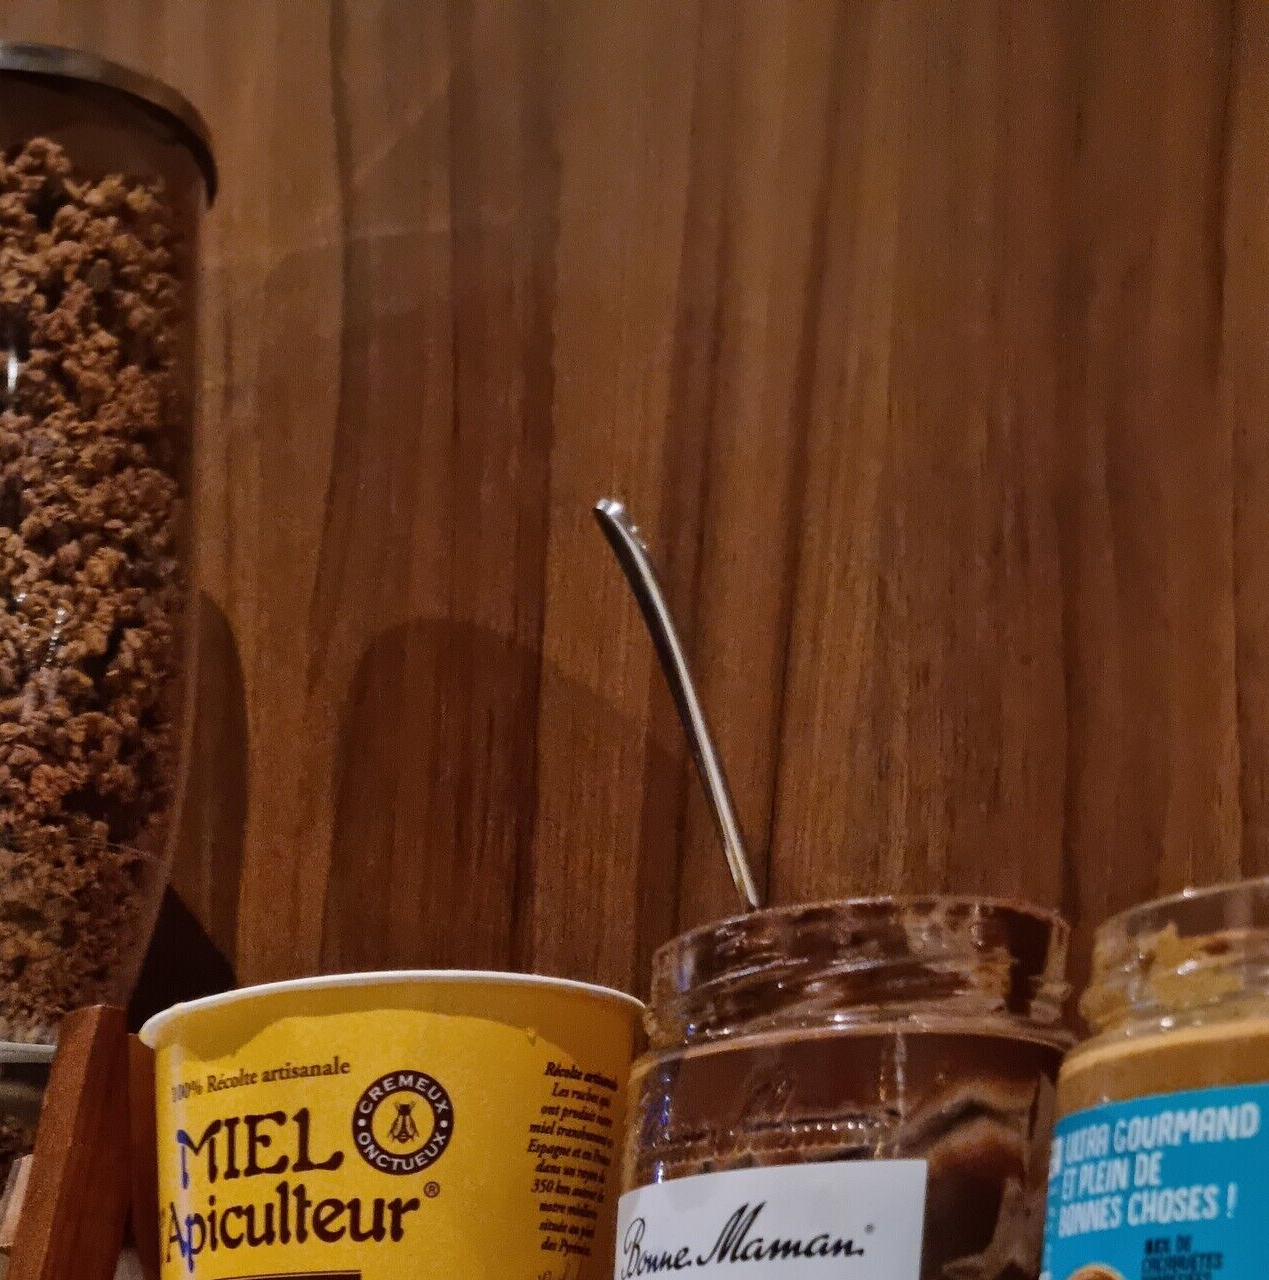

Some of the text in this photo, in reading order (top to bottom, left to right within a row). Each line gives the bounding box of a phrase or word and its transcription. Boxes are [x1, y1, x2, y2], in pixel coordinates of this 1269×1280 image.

[207, 1067, 257, 1093] Récolte
[262, 1056, 351, 1082] artisanale
[359, 1075, 449, 1114] CREMEUX
[176, 1107, 345, 1190] MIEL
[358, 1132, 447, 1171] ONCTUEUX
[1065, 1123, 1110, 1165] ULTRA
[1114, 1102, 1261, 1154] GOURMAND
[531, 1179, 554, 1193] 350
[1078, 1158, 1130, 1196] PLEIN
[1134, 1151, 1163, 1187] DE
[1059, 1197, 1123, 1239] BONNES
[1128, 1184, 1220, 1227] CHOSES
[621, 1217, 692, 1280] Bonne
